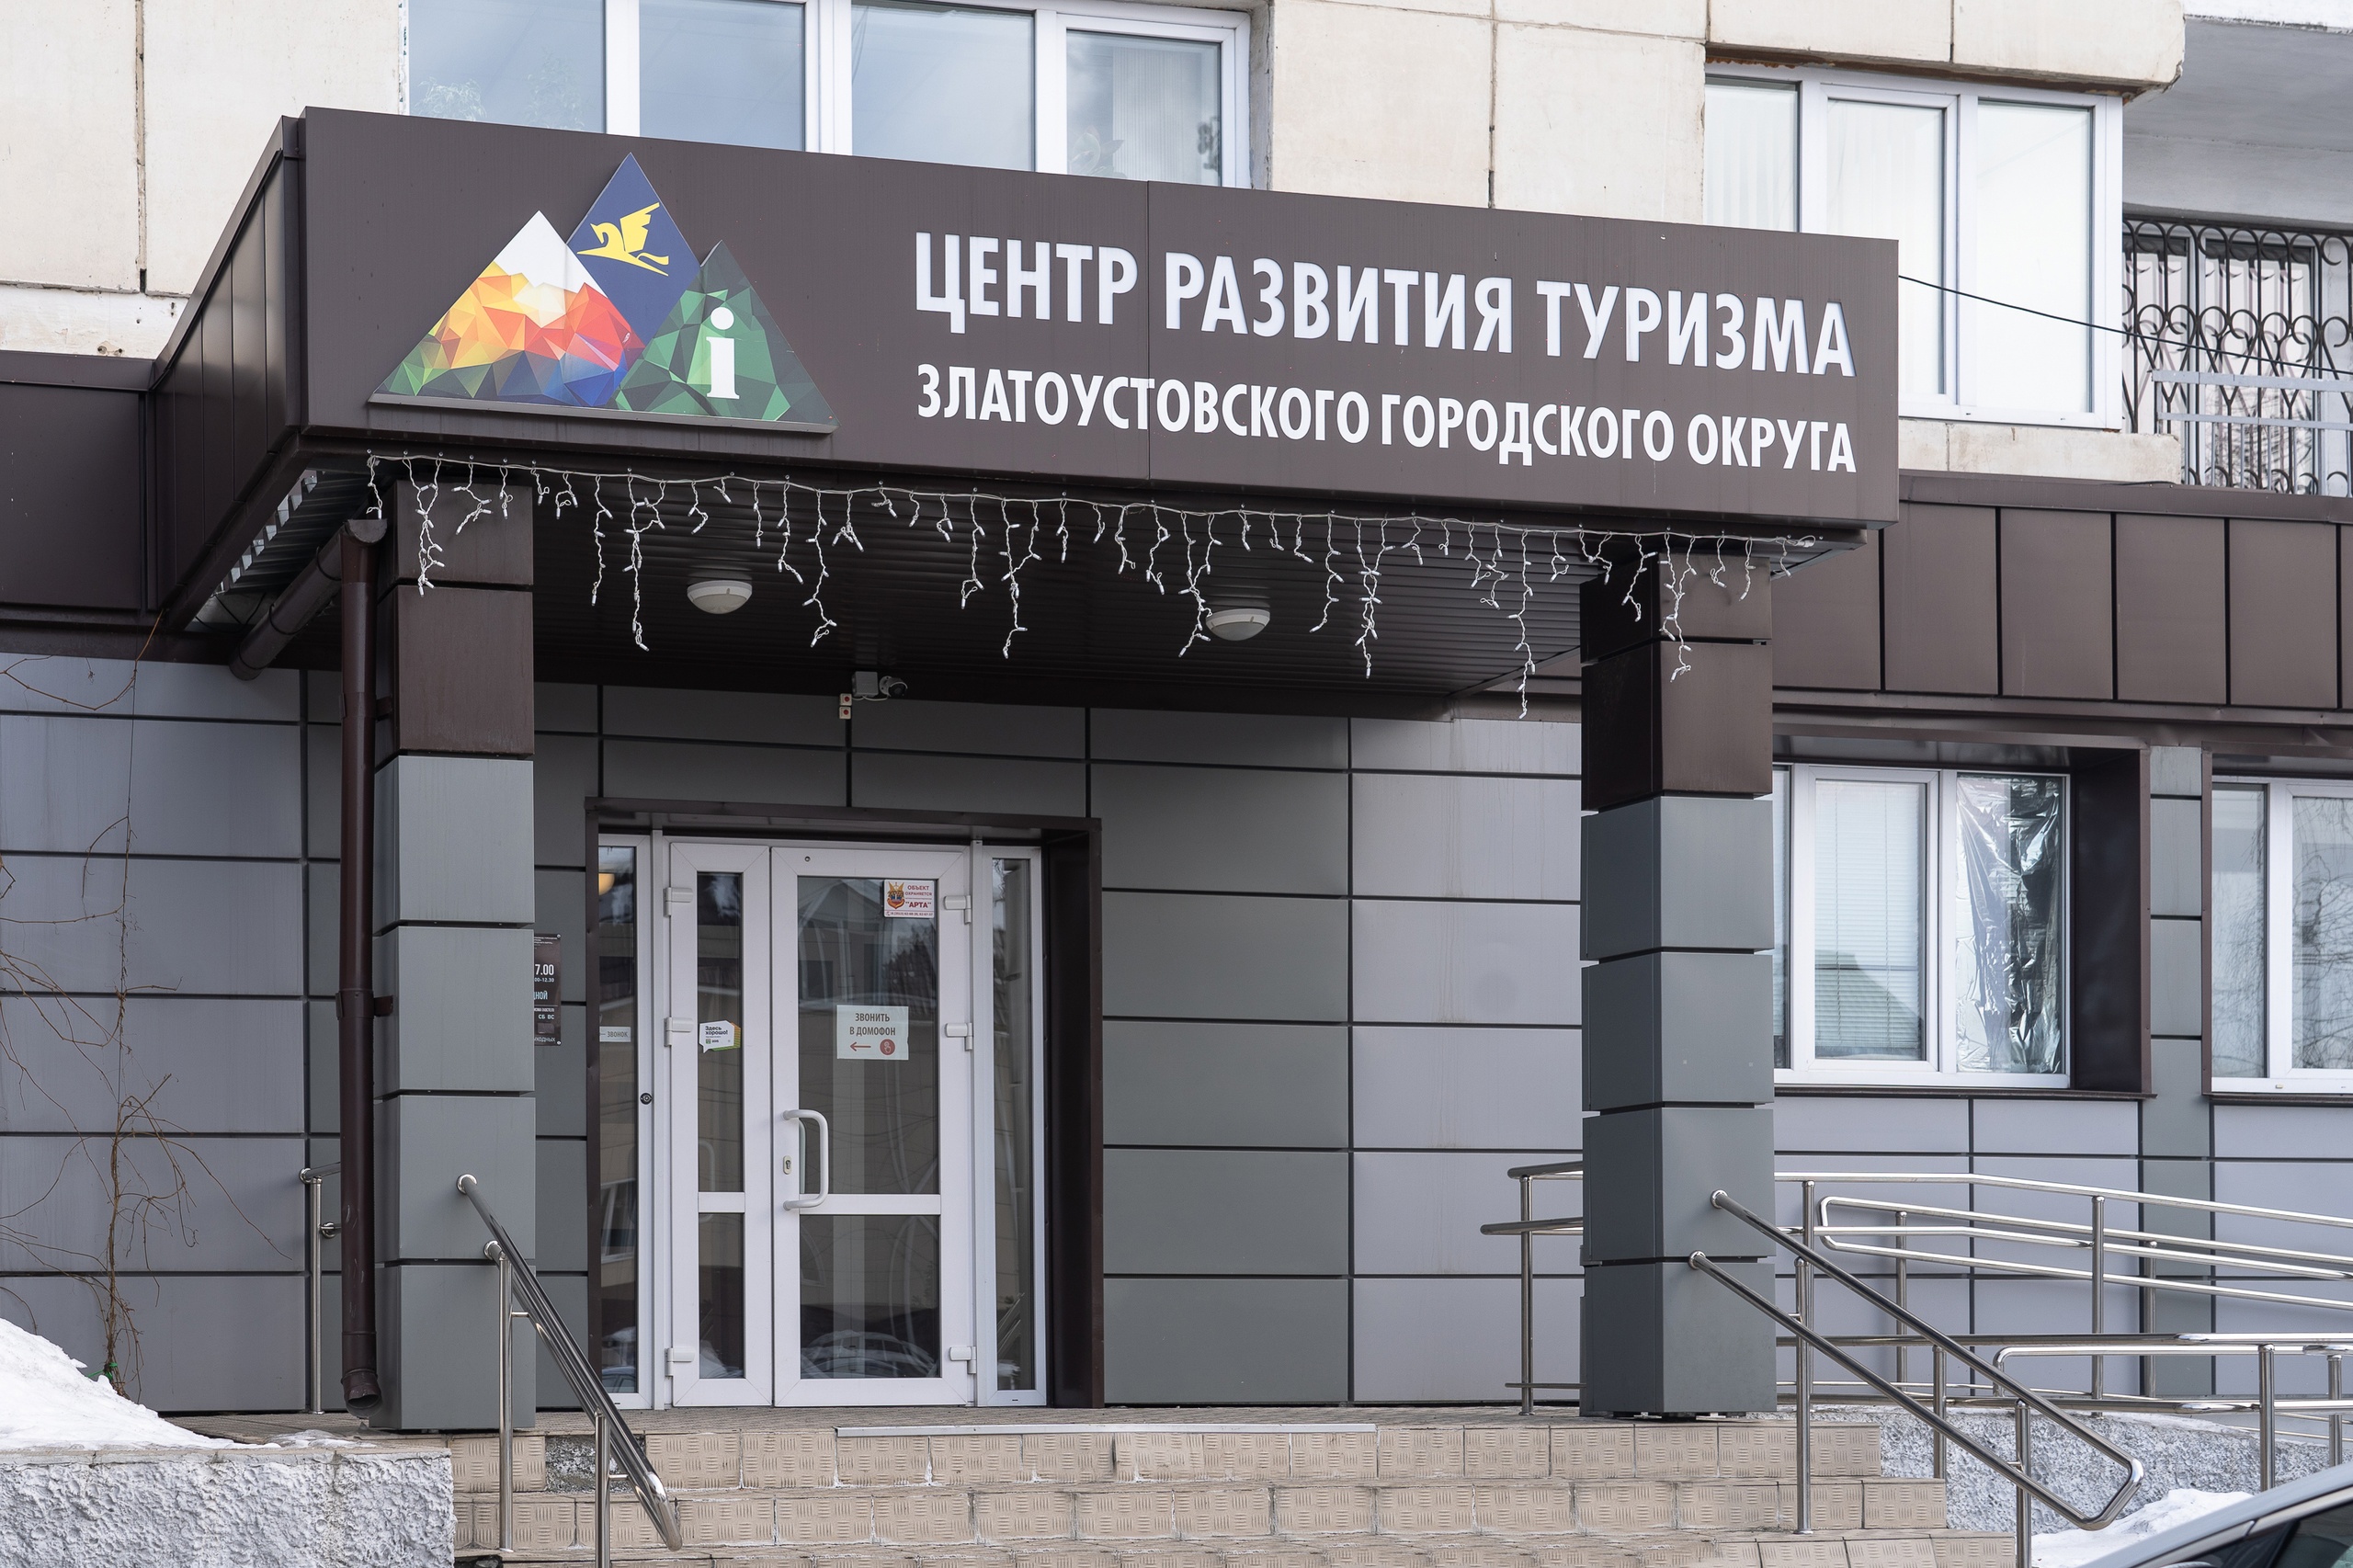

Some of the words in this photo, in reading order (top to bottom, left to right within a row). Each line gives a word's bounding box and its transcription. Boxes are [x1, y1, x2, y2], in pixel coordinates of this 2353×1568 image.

[915, 231, 1139, 335] ЦЕНТР
[1165, 251, 1514, 354] РАЗВИТИЯ
[1535, 278, 1858, 378] ТУРИЗМА
[917, 362, 1370, 444] ЗЛАТОУСТОВСКОГО
[1381, 392, 1676, 467] ГОРОДСКОГО
[1686, 413, 1858, 474] ОКРУГА
[535, 964, 554, 975] 7.00
[533, 991, 548, 1000] НОЙ
[855, 1013, 891, 1022] ЗВОНИТЬ
[849, 1027, 855, 1035] В
[856, 1027, 896, 1037] ДОМОФОН
